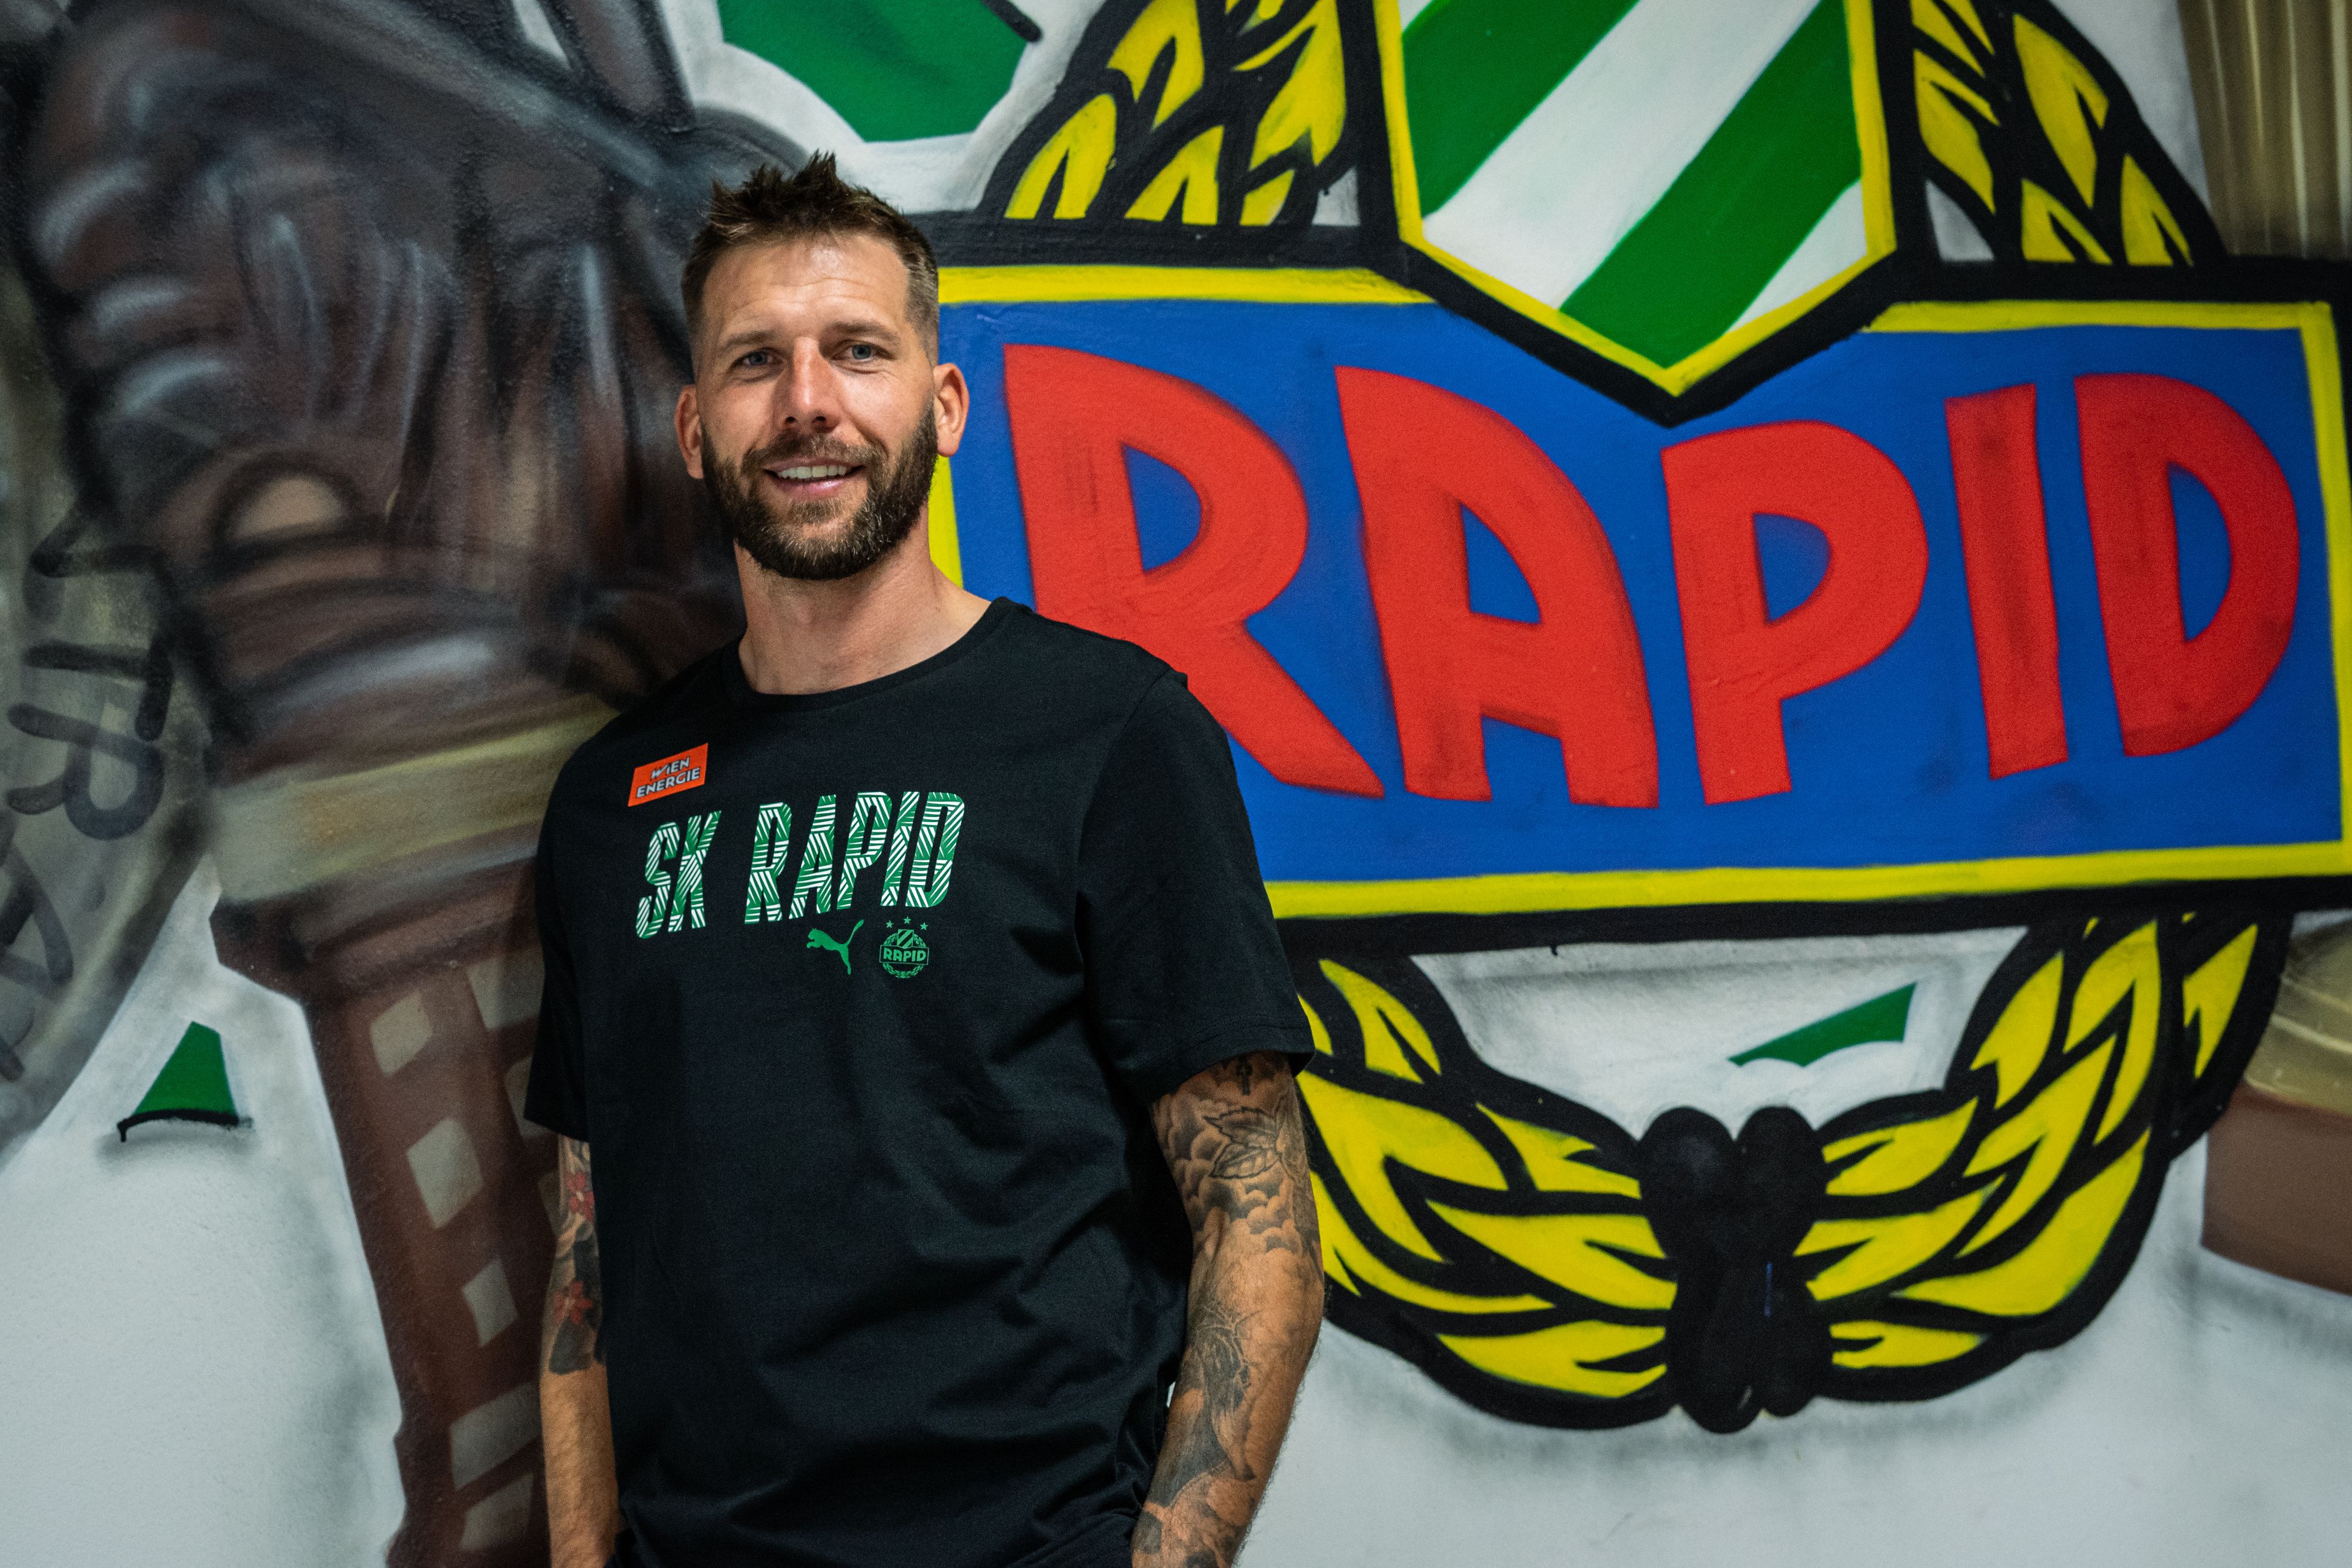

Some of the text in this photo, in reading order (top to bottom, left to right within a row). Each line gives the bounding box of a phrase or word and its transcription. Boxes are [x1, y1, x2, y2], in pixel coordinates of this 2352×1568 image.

[1003, 343, 2300, 808] RAPID
[636, 767, 701, 799] ENERGIE
[650, 757, 690, 780] WIEN
[635, 791, 965, 940] SK RAPID
[883, 947, 927, 962] RAPID
